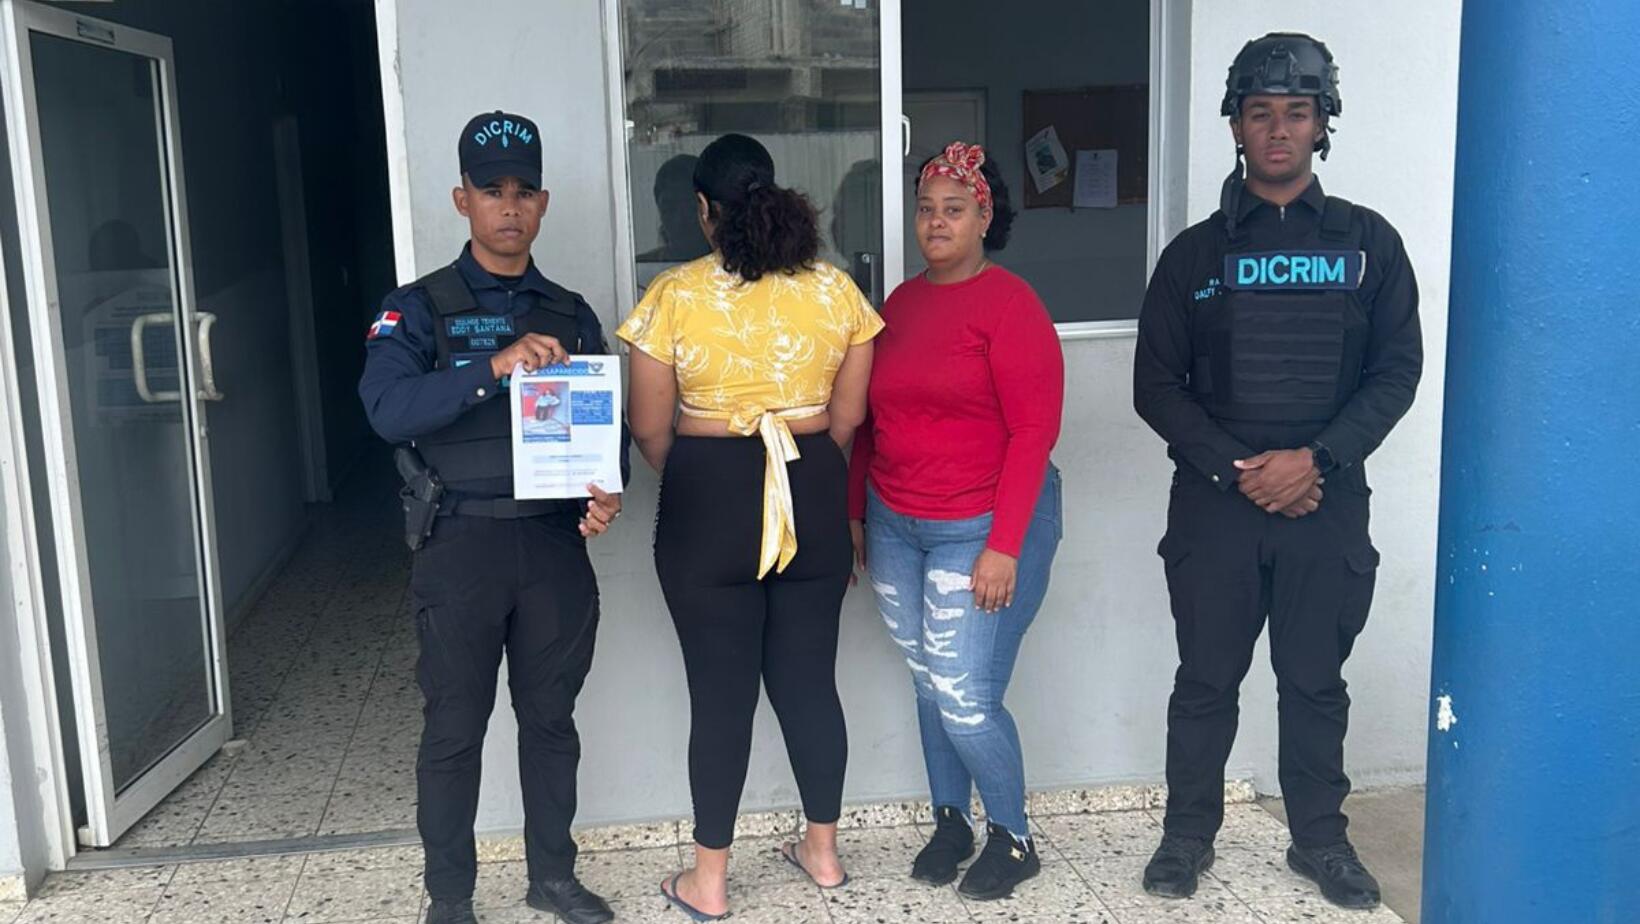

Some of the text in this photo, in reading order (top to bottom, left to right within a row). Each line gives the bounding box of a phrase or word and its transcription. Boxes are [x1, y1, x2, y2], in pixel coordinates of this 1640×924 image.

[474, 120, 532, 146] DICRIM
[1237, 255, 1346, 285] DICRIM
[474, 323, 511, 333] SANTANA
